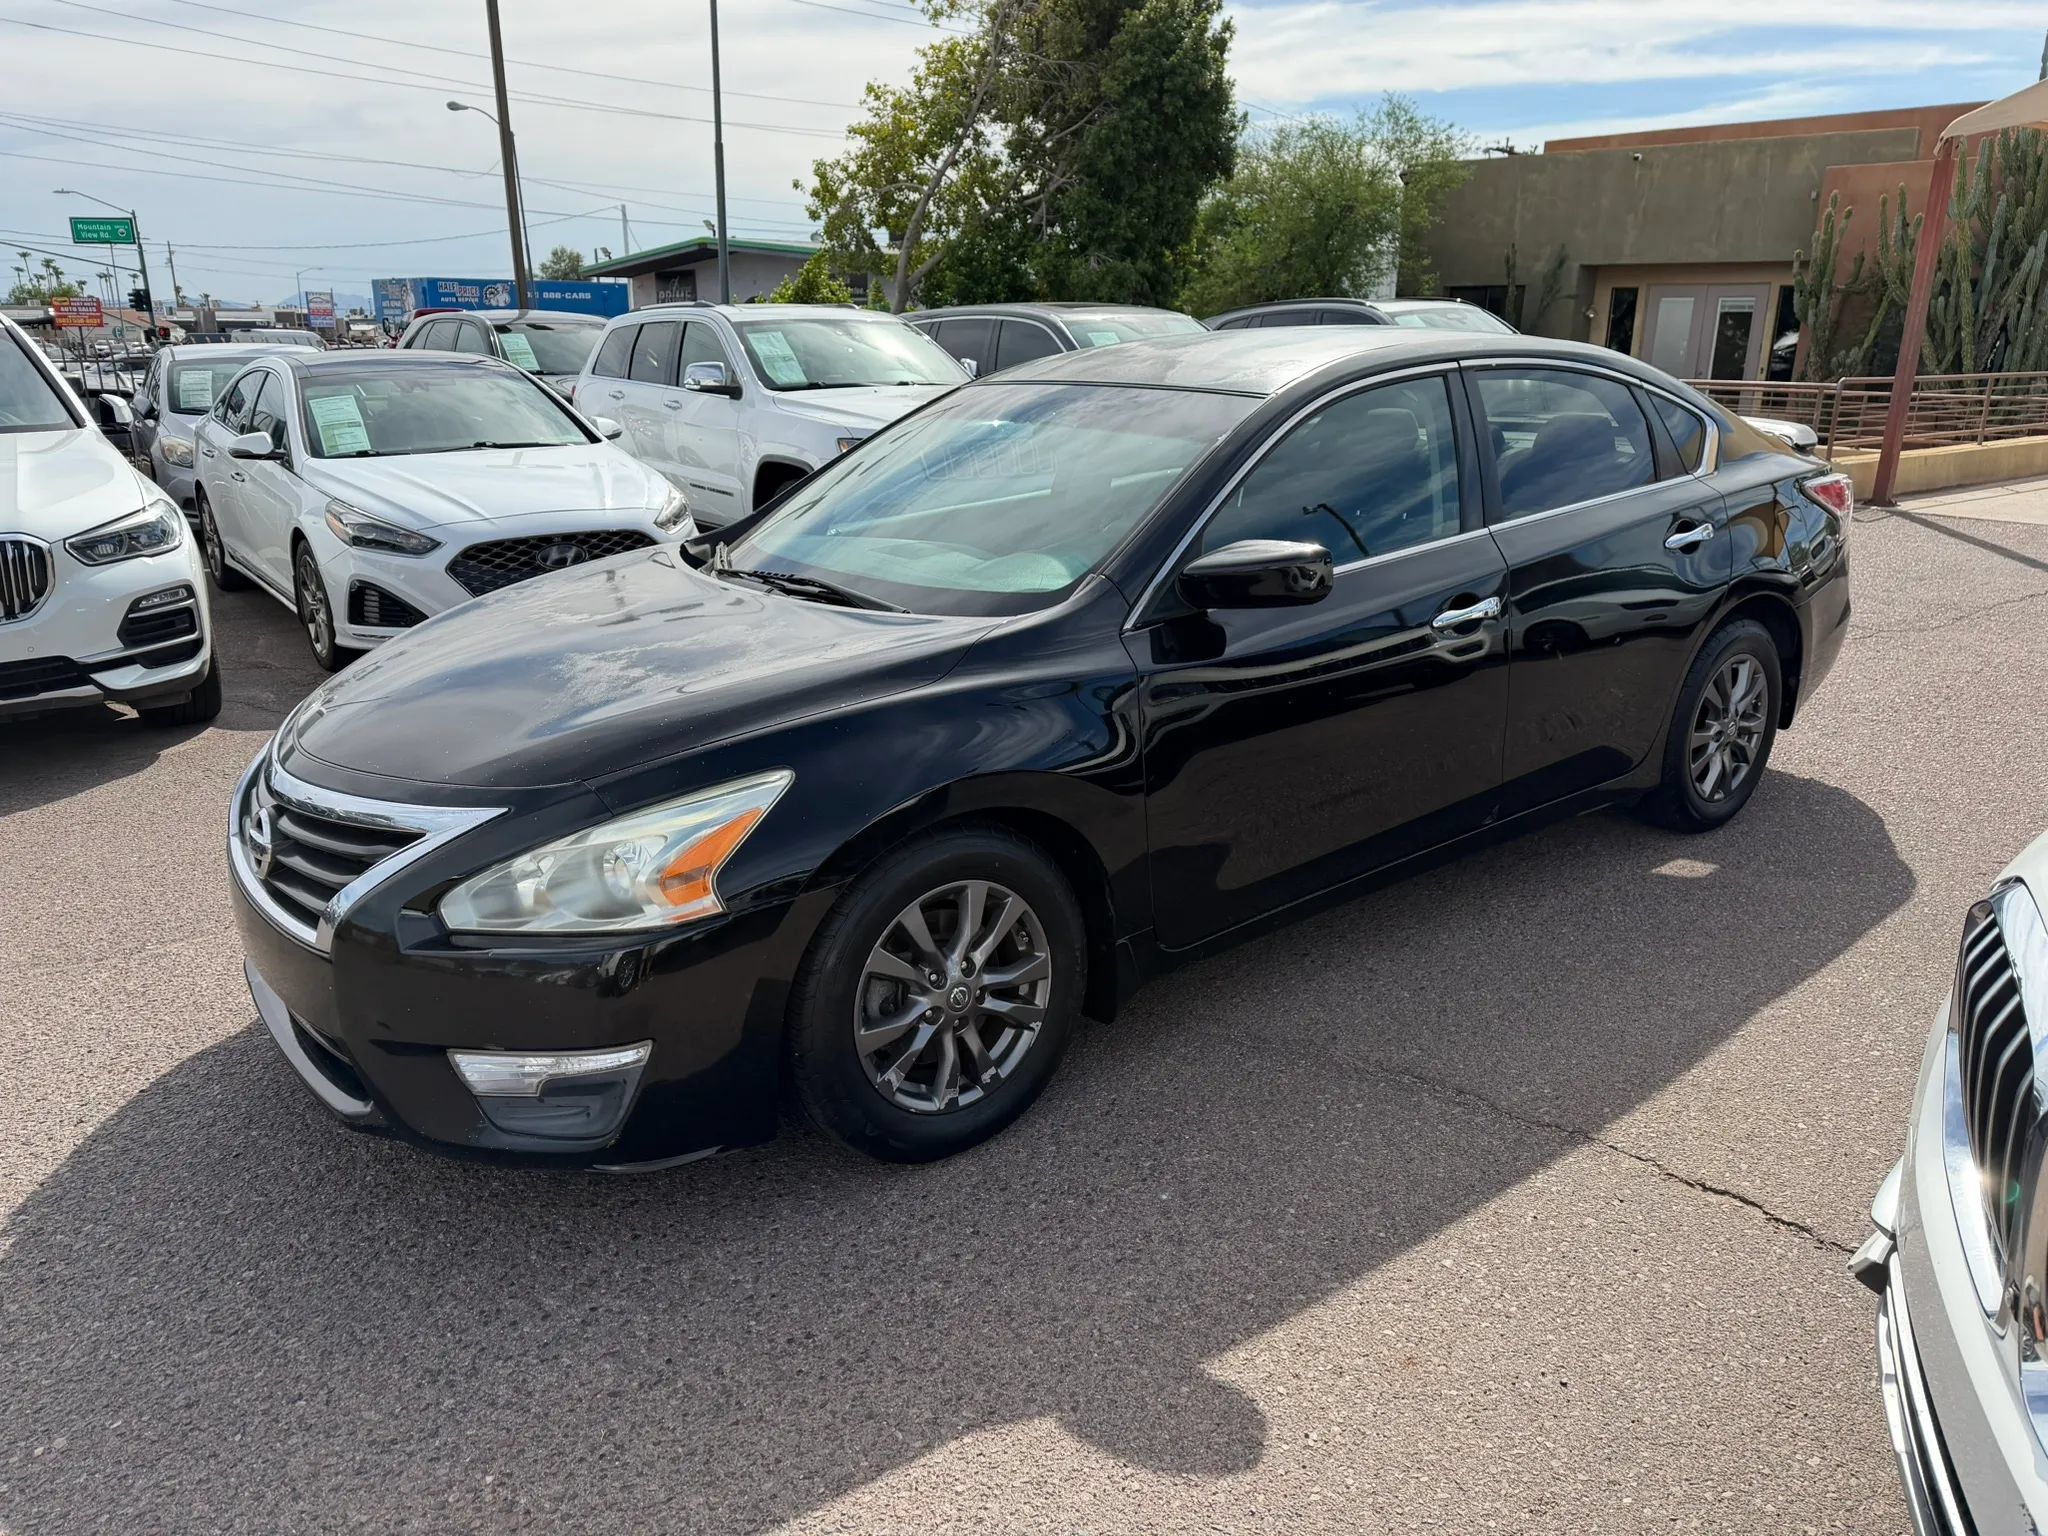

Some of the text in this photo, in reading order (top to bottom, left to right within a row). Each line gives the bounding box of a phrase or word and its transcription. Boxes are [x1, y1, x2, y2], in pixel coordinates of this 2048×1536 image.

[81, 231, 111, 239] View Rd.
[438, 281, 457, 291] HALF
[457, 286, 479, 296] PRICE
